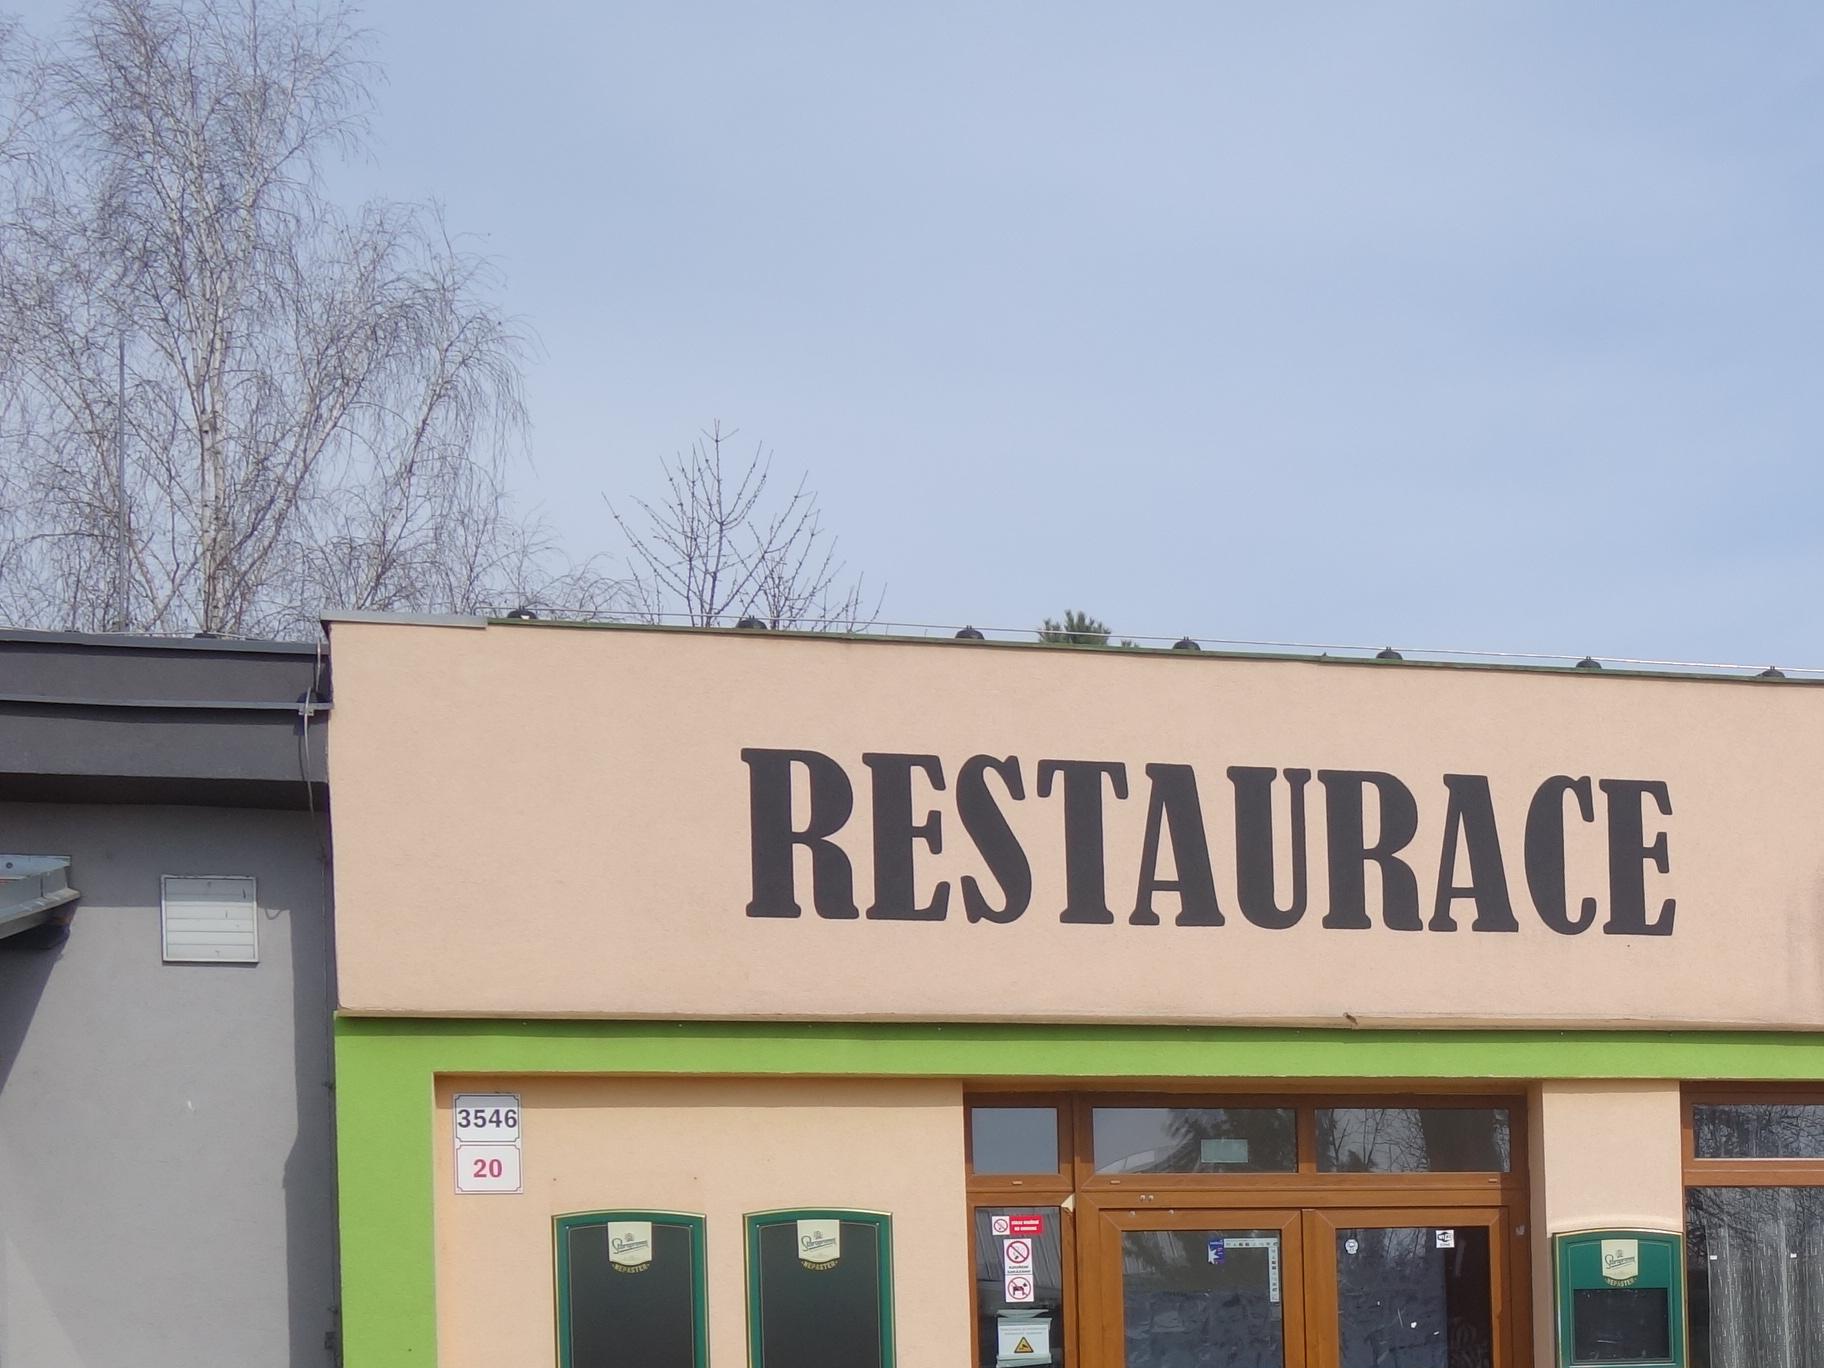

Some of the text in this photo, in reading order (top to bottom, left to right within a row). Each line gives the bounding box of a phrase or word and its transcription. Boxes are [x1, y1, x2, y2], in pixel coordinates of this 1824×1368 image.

[740, 747, 1678, 936] RESTAURACE
[457, 1108, 518, 1128] 3546
[473, 1158, 503, 1178] 20
